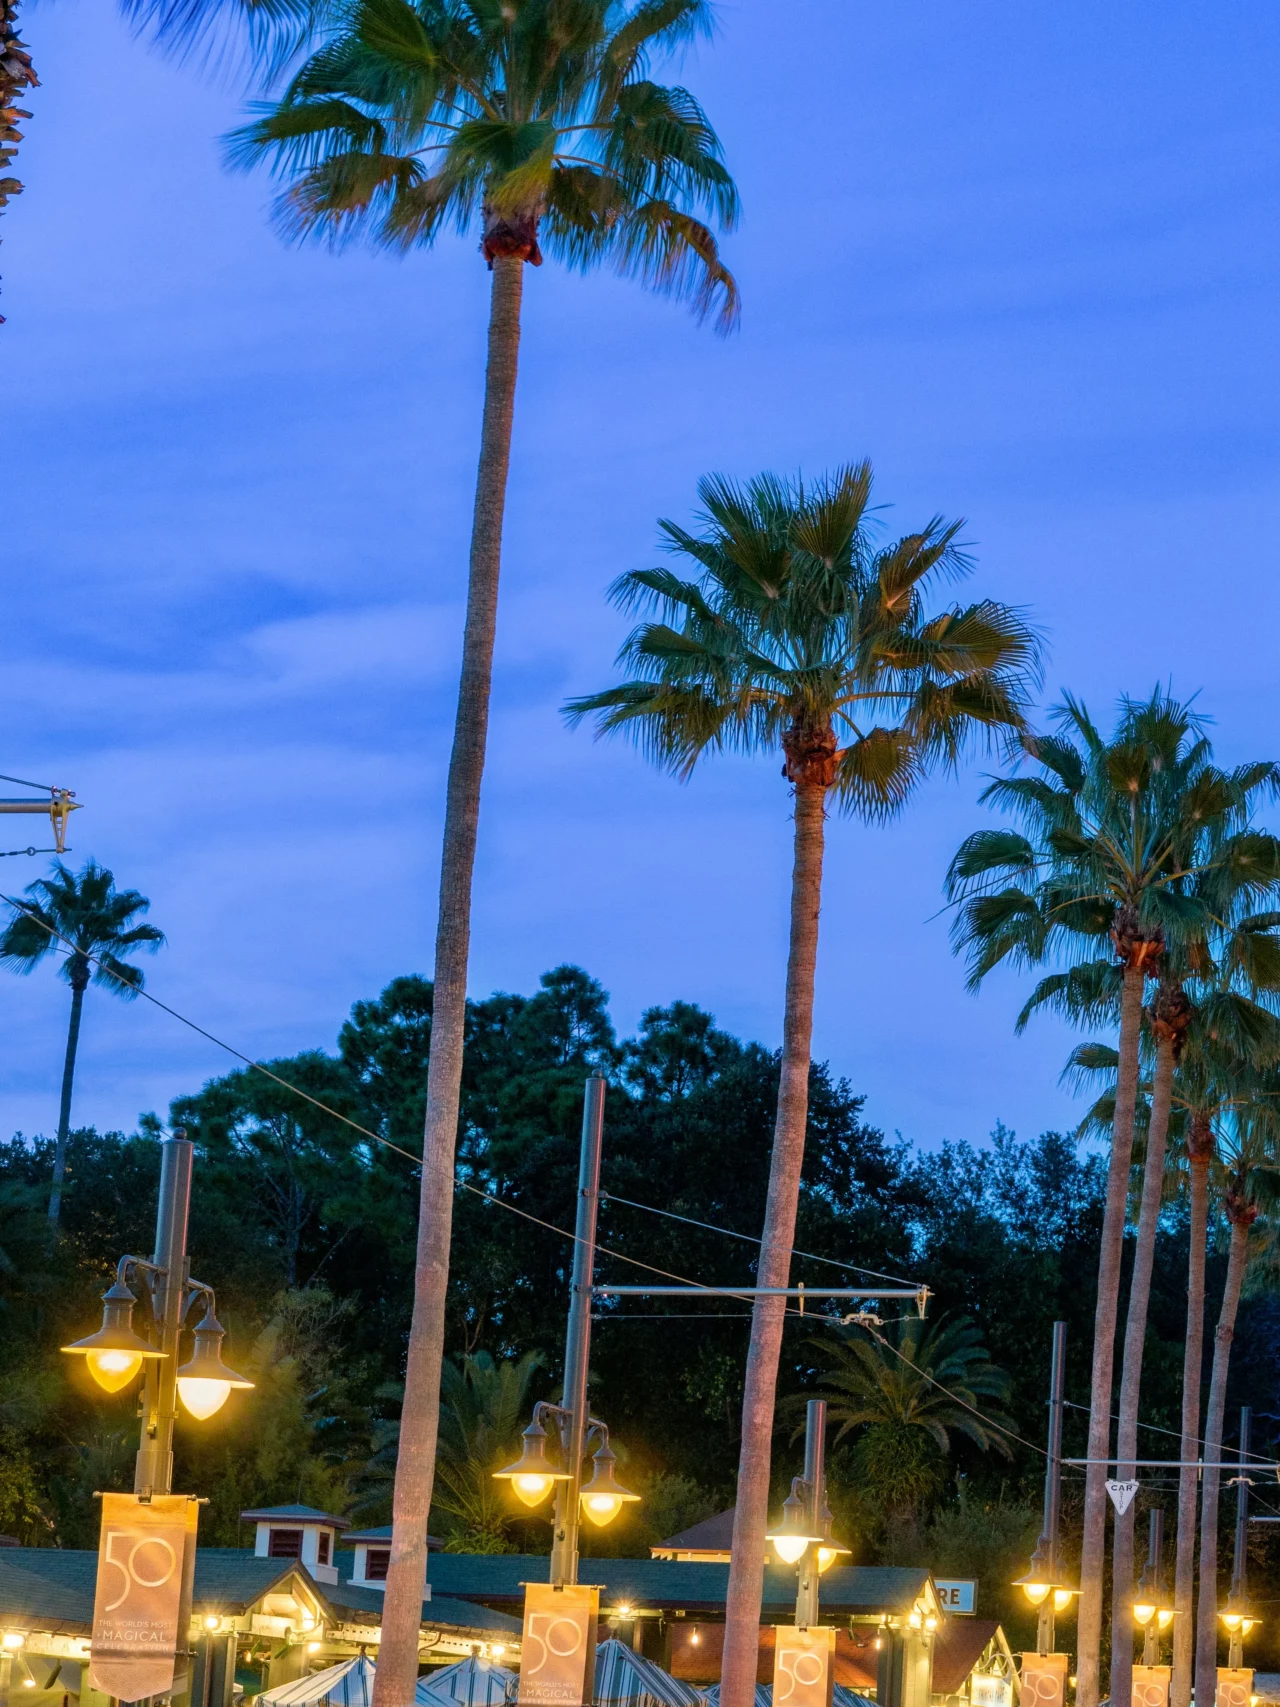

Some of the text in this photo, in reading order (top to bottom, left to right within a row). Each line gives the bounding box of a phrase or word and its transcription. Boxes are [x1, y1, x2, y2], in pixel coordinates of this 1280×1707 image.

[105, 1531, 177, 1612] 50
[102, 1630, 166, 1642] MAGICAL
[115, 1620, 149, 1628] WORLD'S
[151, 1621, 172, 1629] MOST
[527, 1613, 582, 1675] 50
[779, 1649, 823, 1701] 50
[1024, 1671, 1060, 1707] 50
[526, 1689, 575, 1699] MAGICAL
